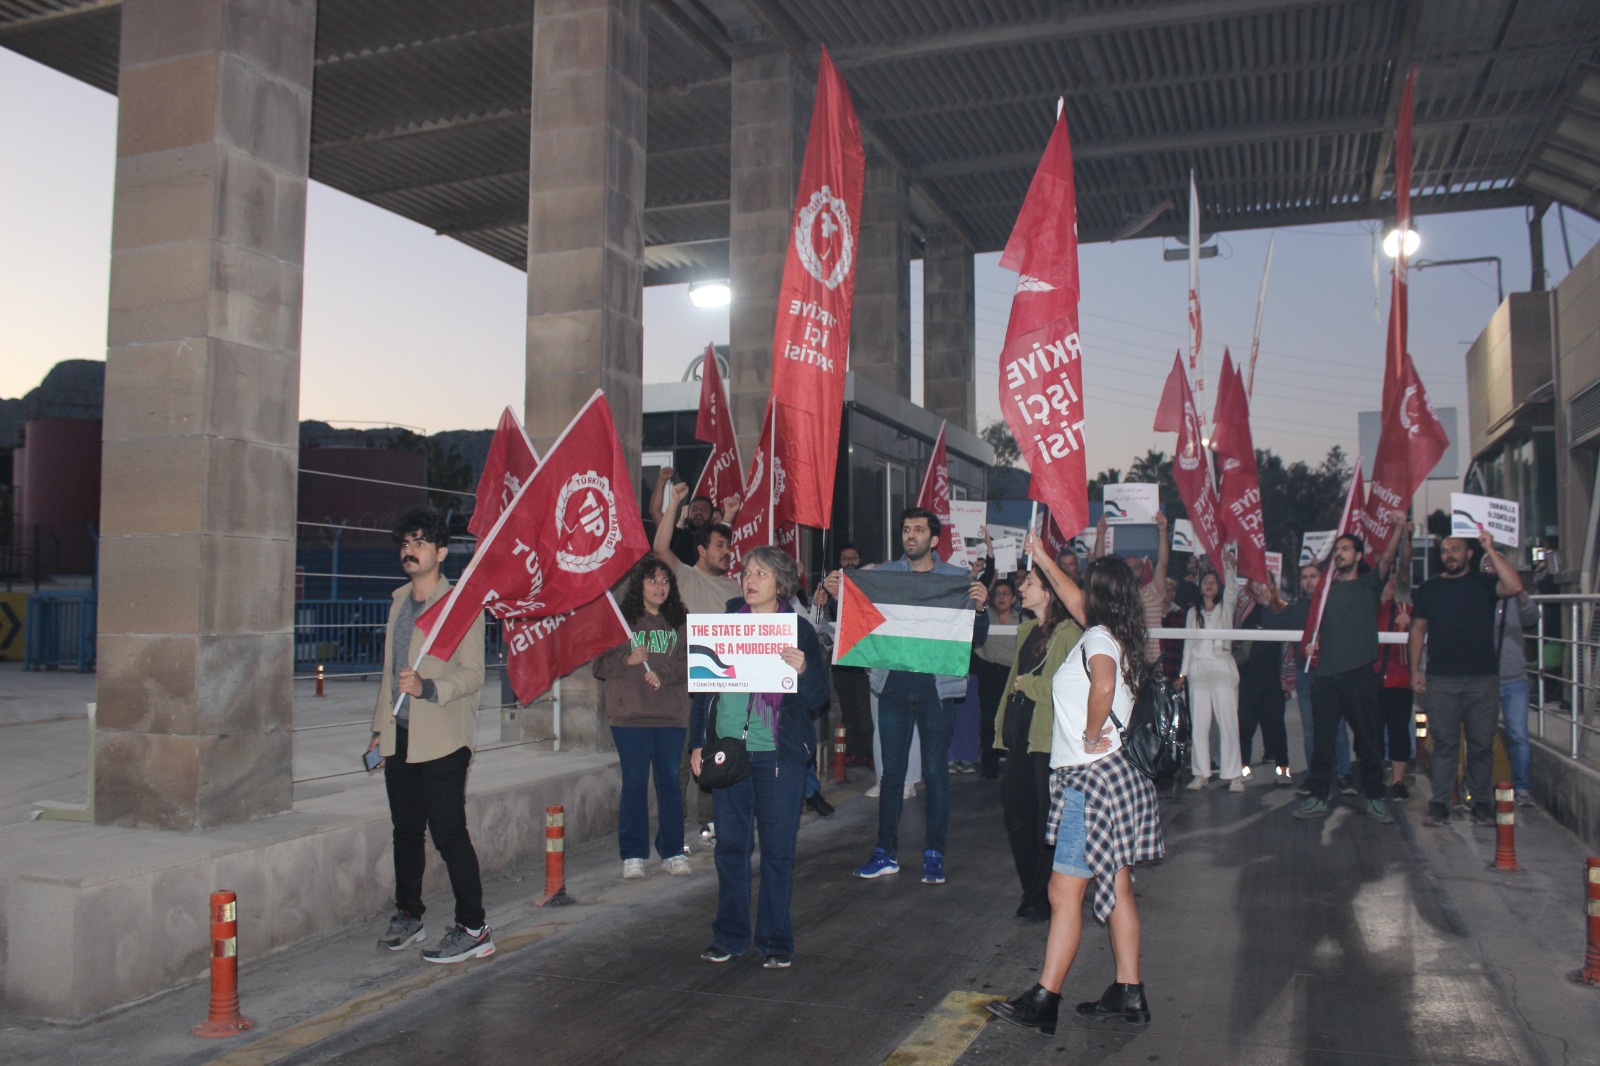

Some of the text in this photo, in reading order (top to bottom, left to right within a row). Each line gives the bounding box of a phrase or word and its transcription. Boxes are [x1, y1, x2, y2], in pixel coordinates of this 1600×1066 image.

[575, 476, 606, 490] TÜRKİYE
[578, 490, 605, 537] TİP
[605, 513, 618, 551] PARTİSİ
[691, 624, 794, 636] THE STATE OF ISRAEL
[714, 643, 726, 655] IS
[727, 643, 734, 655] A
[716, 681, 728, 689] İŞÇİ
